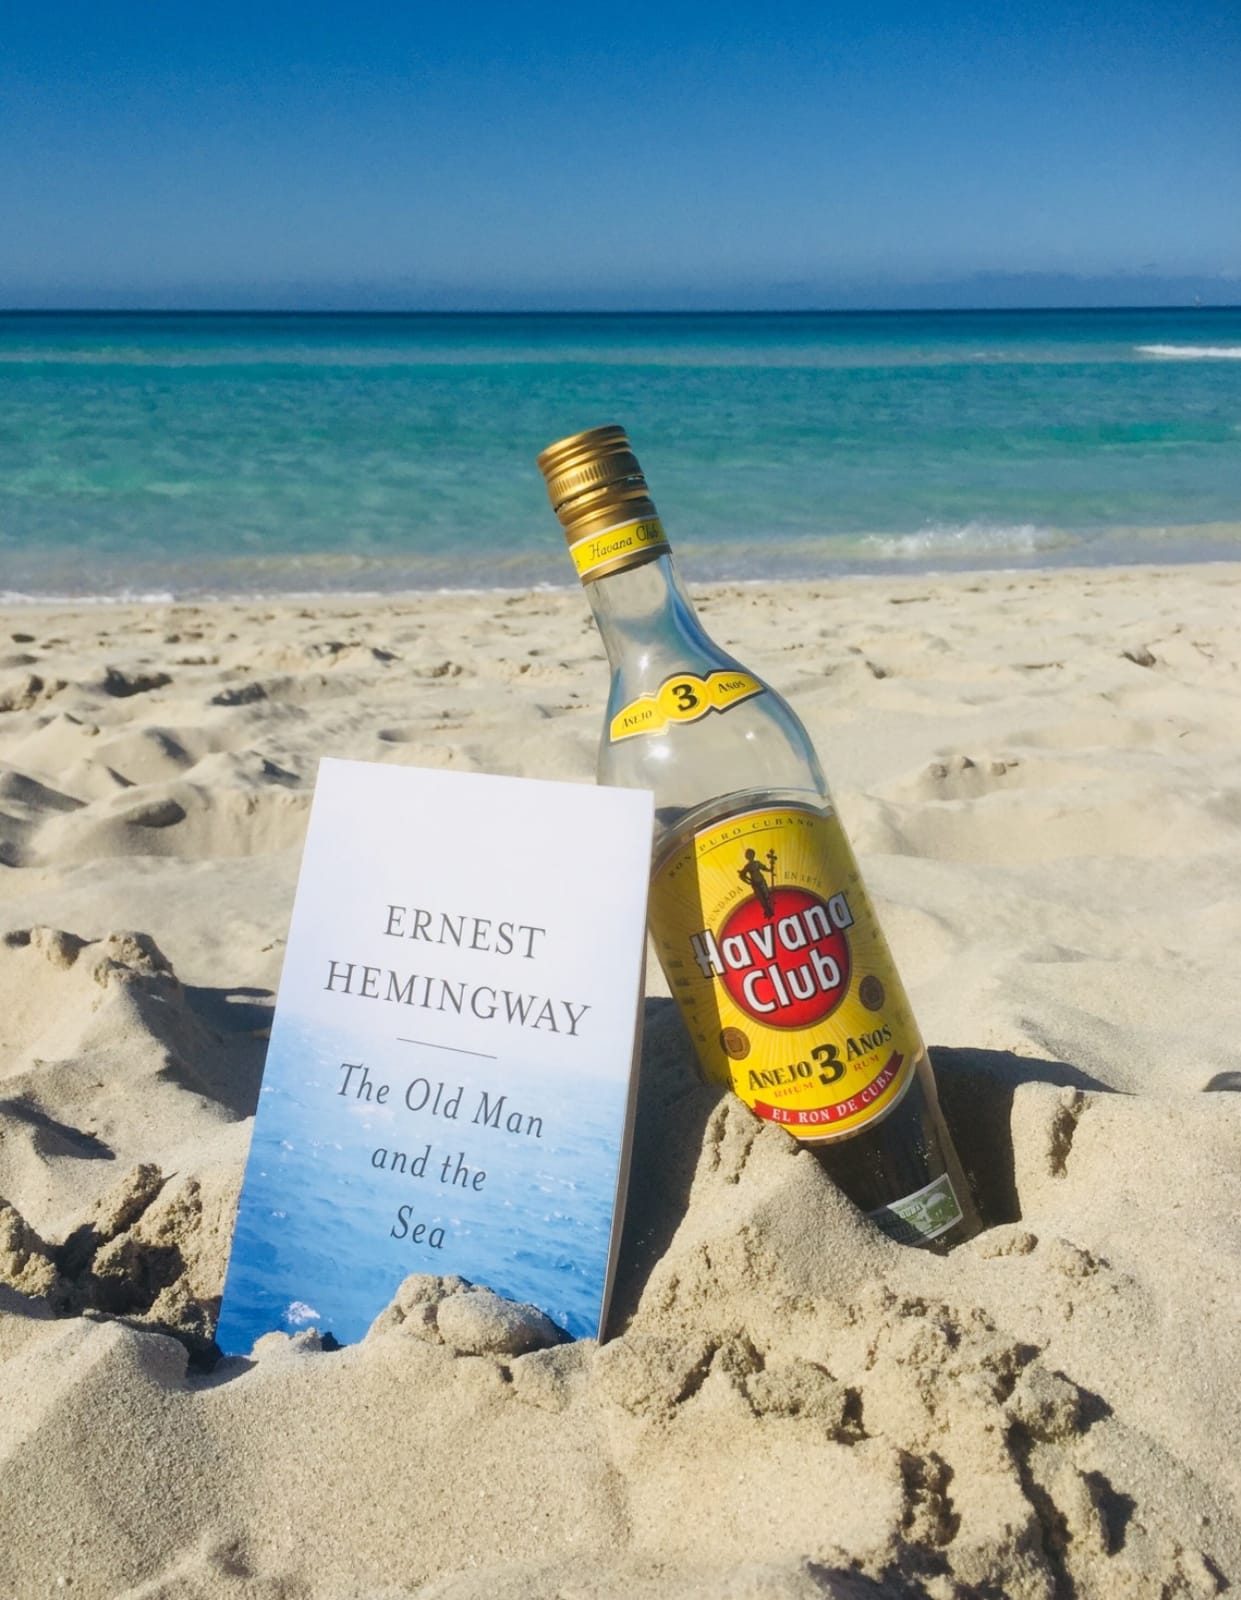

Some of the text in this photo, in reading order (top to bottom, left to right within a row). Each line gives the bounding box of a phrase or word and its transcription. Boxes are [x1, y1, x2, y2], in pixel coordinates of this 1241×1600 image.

[589, 536, 633, 561] Havana
[671, 683, 699, 712] 3
[700, 827, 742, 852] PURO
[383, 904, 546, 960] ERNEST
[689, 891, 854, 979] Havana
[323, 960, 592, 1037] HEMINGWAY
[742, 948, 842, 1014] Club
[811, 1043, 846, 1086] 3
[853, 1054, 880, 1072] RUM
[337, 1063, 544, 1138] The Old Man
[771, 1069, 894, 1124] EL RON DE CUBA
[371, 1145, 487, 1192] and the
[390, 1204, 446, 1250] Sea
